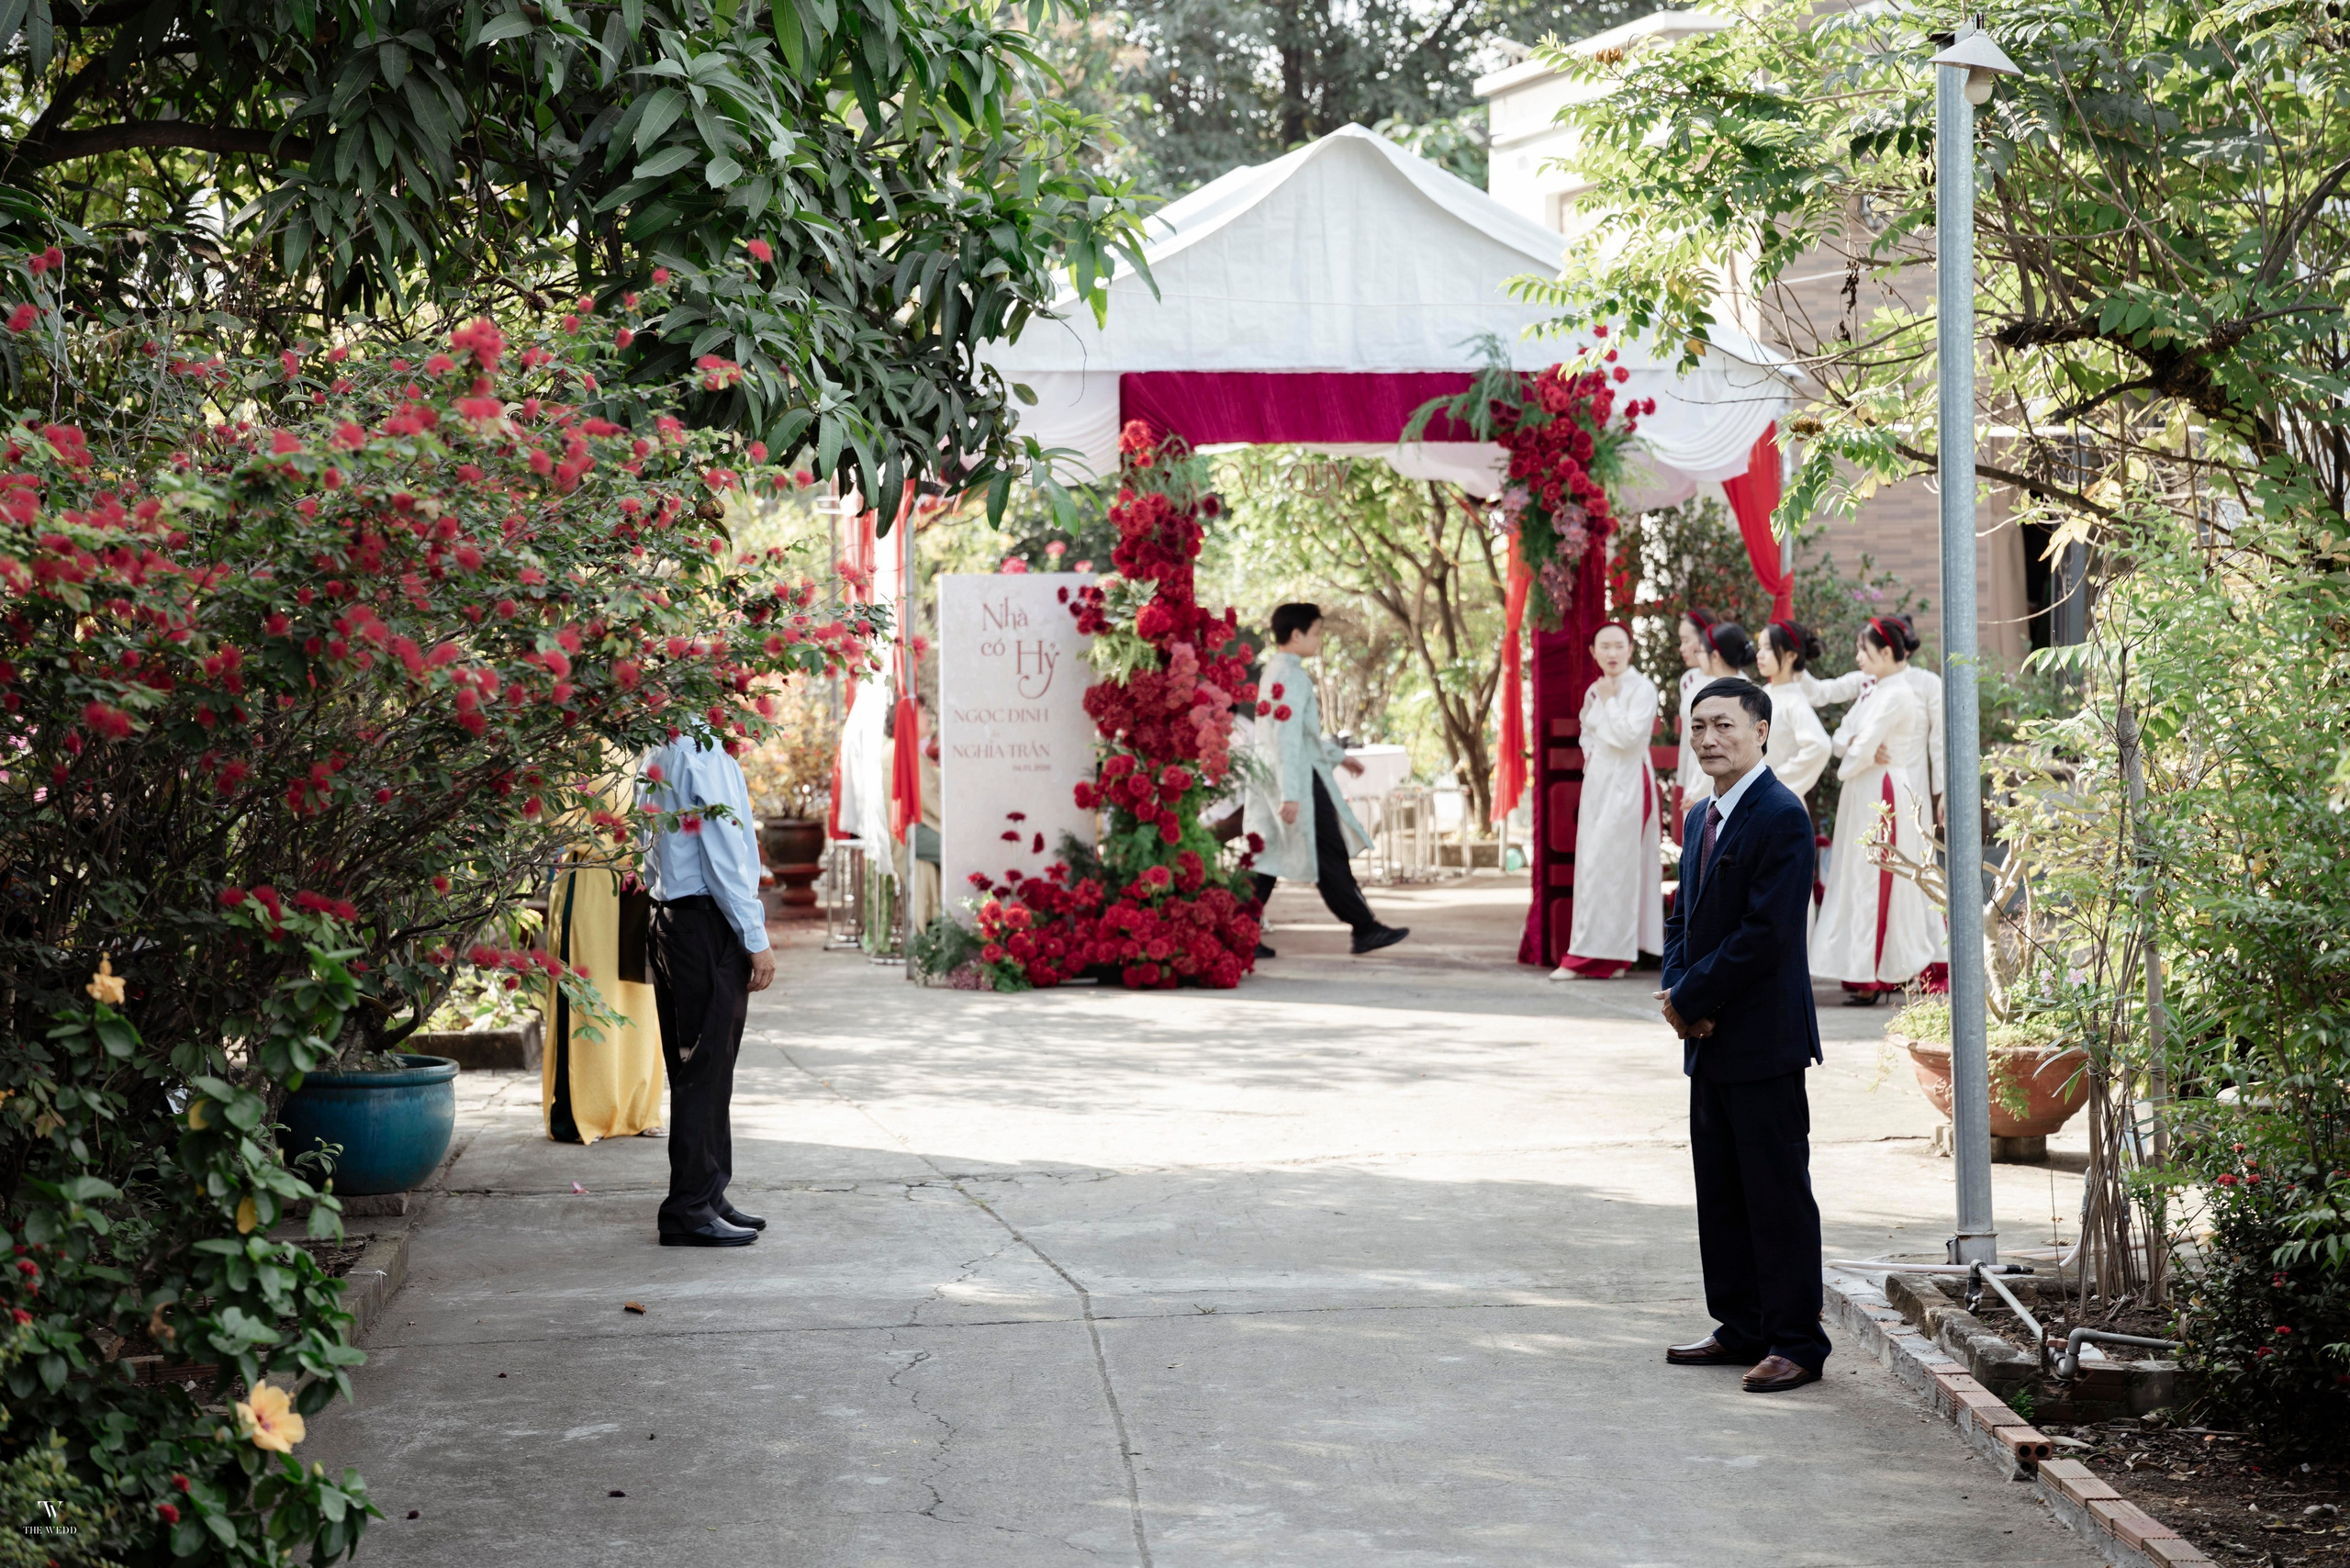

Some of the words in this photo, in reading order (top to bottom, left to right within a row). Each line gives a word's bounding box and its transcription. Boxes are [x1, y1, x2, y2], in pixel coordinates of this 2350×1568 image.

[1288, 463, 1349, 498] QUY
[982, 597, 1028, 632] Nhà
[980, 637, 1006, 657] có
[1016, 640, 1060, 700] Hỷ
